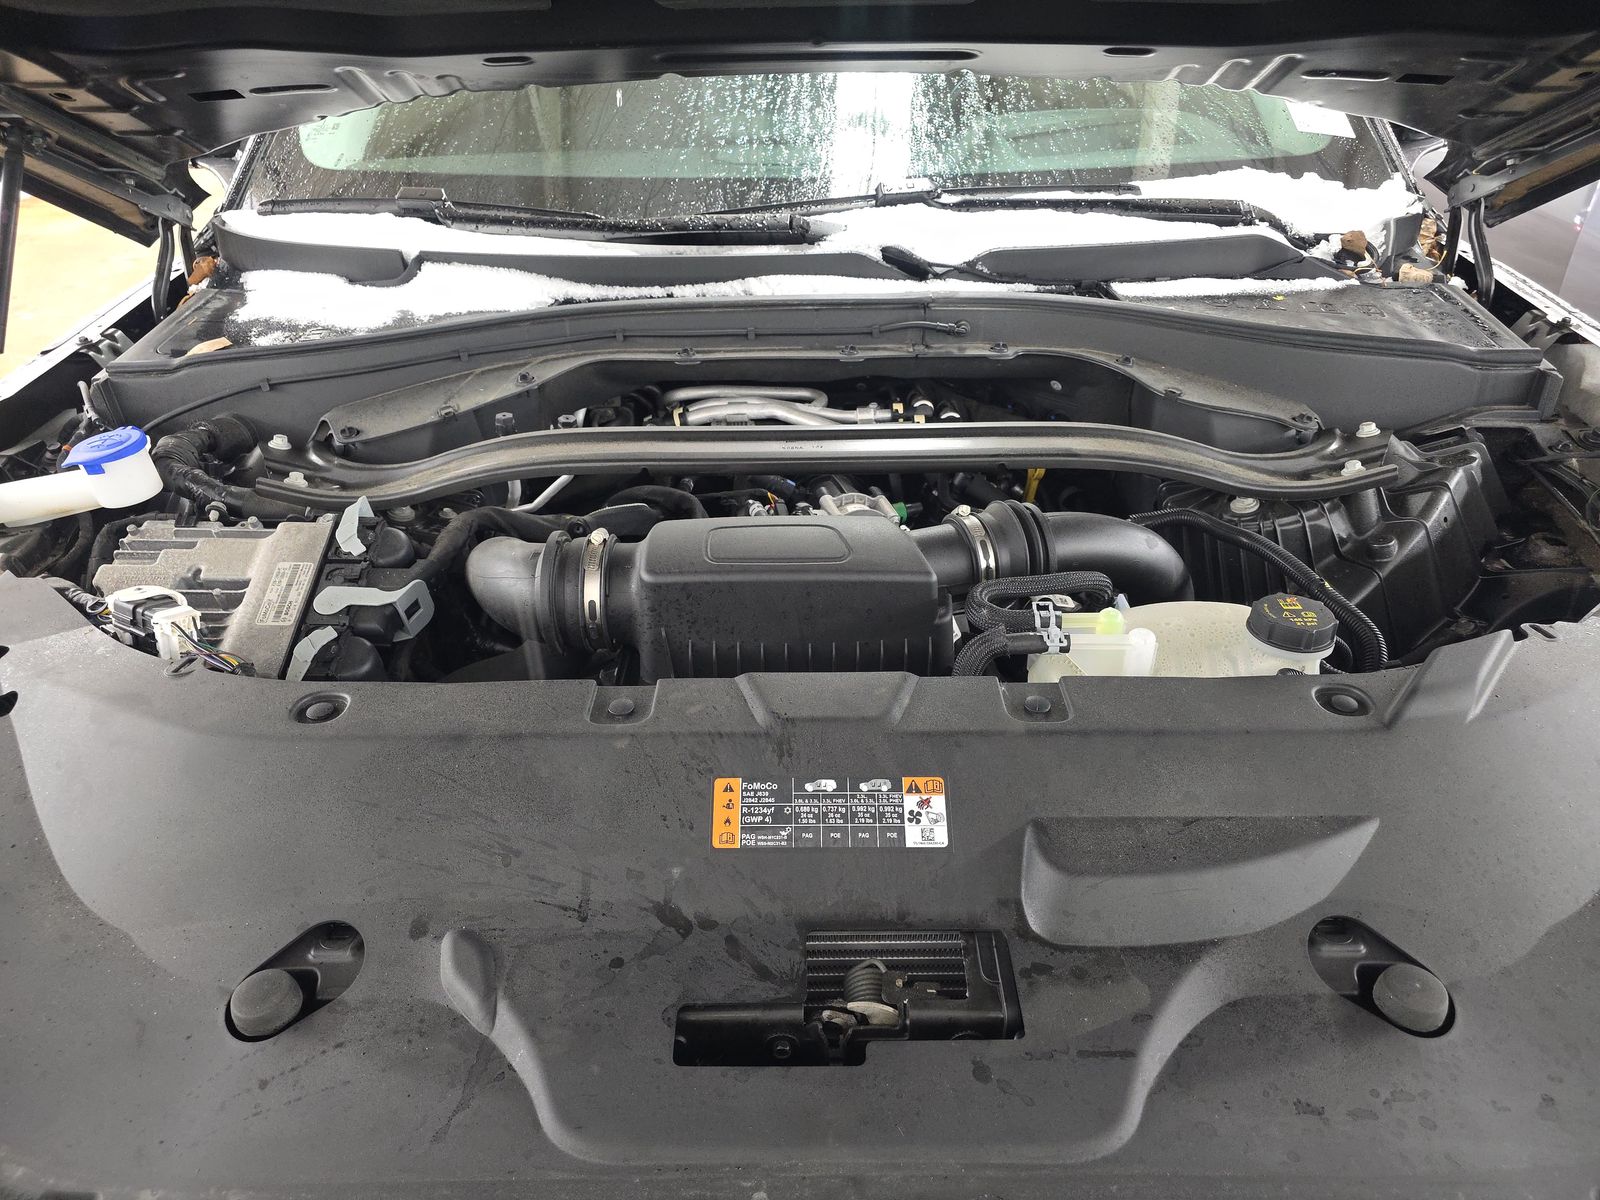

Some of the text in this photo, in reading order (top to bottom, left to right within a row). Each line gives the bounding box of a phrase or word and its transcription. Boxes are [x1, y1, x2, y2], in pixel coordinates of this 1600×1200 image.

[742, 782, 778, 790] FoMoCo
[742, 806, 775, 815] R-1234yf
[742, 816, 772, 824] (GWP 4)
